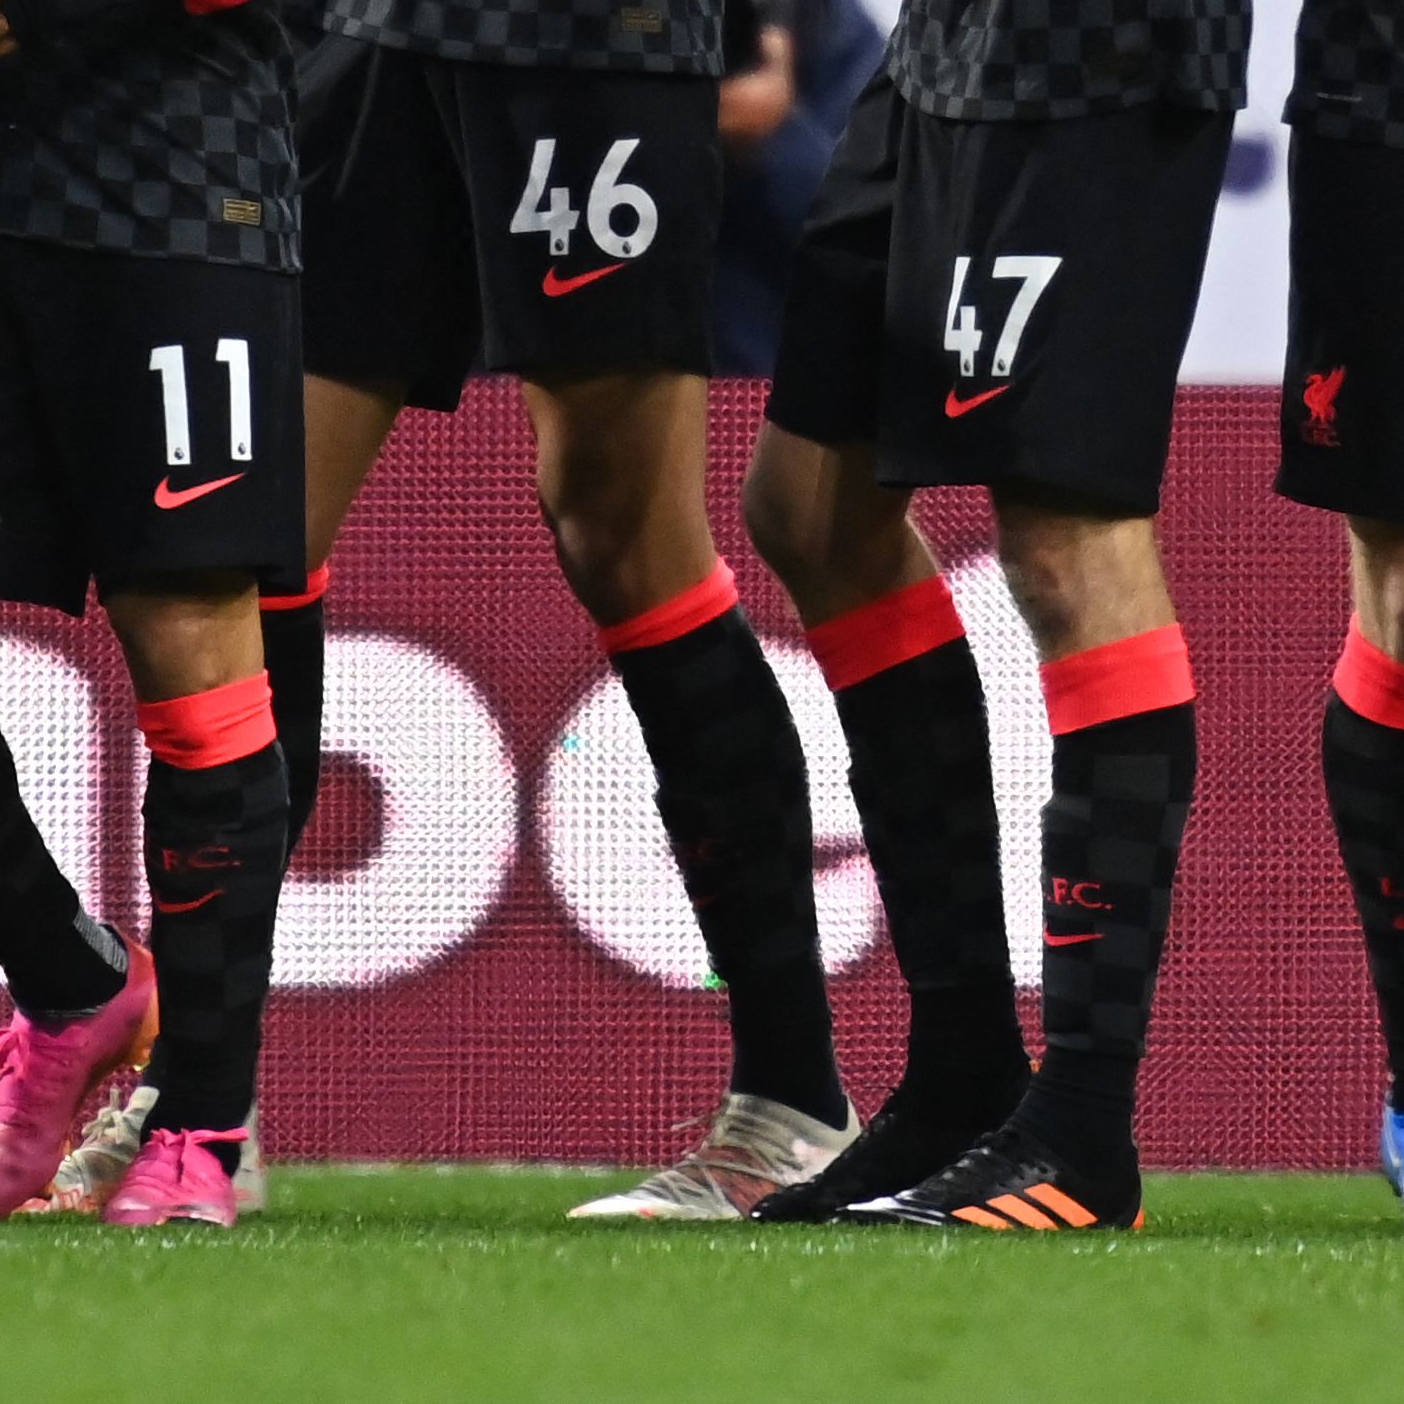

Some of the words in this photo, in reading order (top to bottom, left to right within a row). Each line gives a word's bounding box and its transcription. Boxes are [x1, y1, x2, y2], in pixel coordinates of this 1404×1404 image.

[509, 138, 659, 259] 46
[943, 255, 1064, 378] 47
[148, 338, 253, 466] 11
